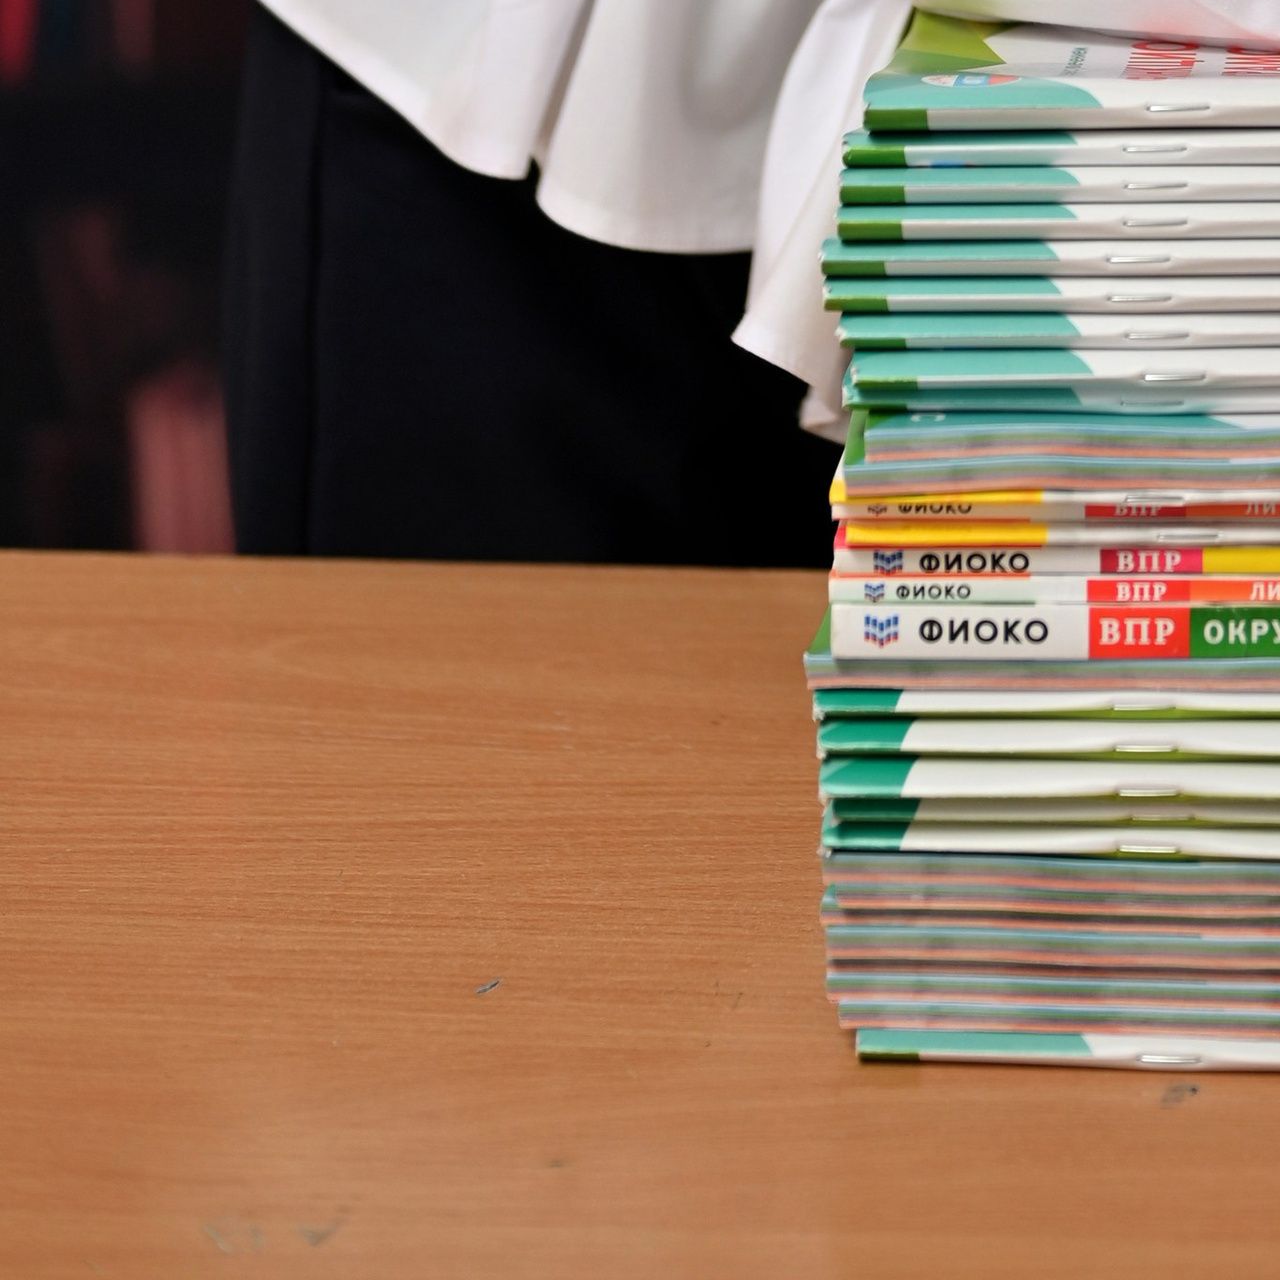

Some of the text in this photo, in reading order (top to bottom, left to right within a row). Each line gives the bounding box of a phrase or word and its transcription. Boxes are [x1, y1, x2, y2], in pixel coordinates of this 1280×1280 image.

[1114, 503, 1162, 516] ВПР
[919, 552, 1030, 573] ФИОКО
[1116, 550, 1181, 572] ВПР
[896, 583, 971, 600] ФИОКО
[1116, 581, 1167, 602] ВПР
[919, 618, 1049, 644] ФИОКО
[1099, 617, 1175, 645] ВПР
